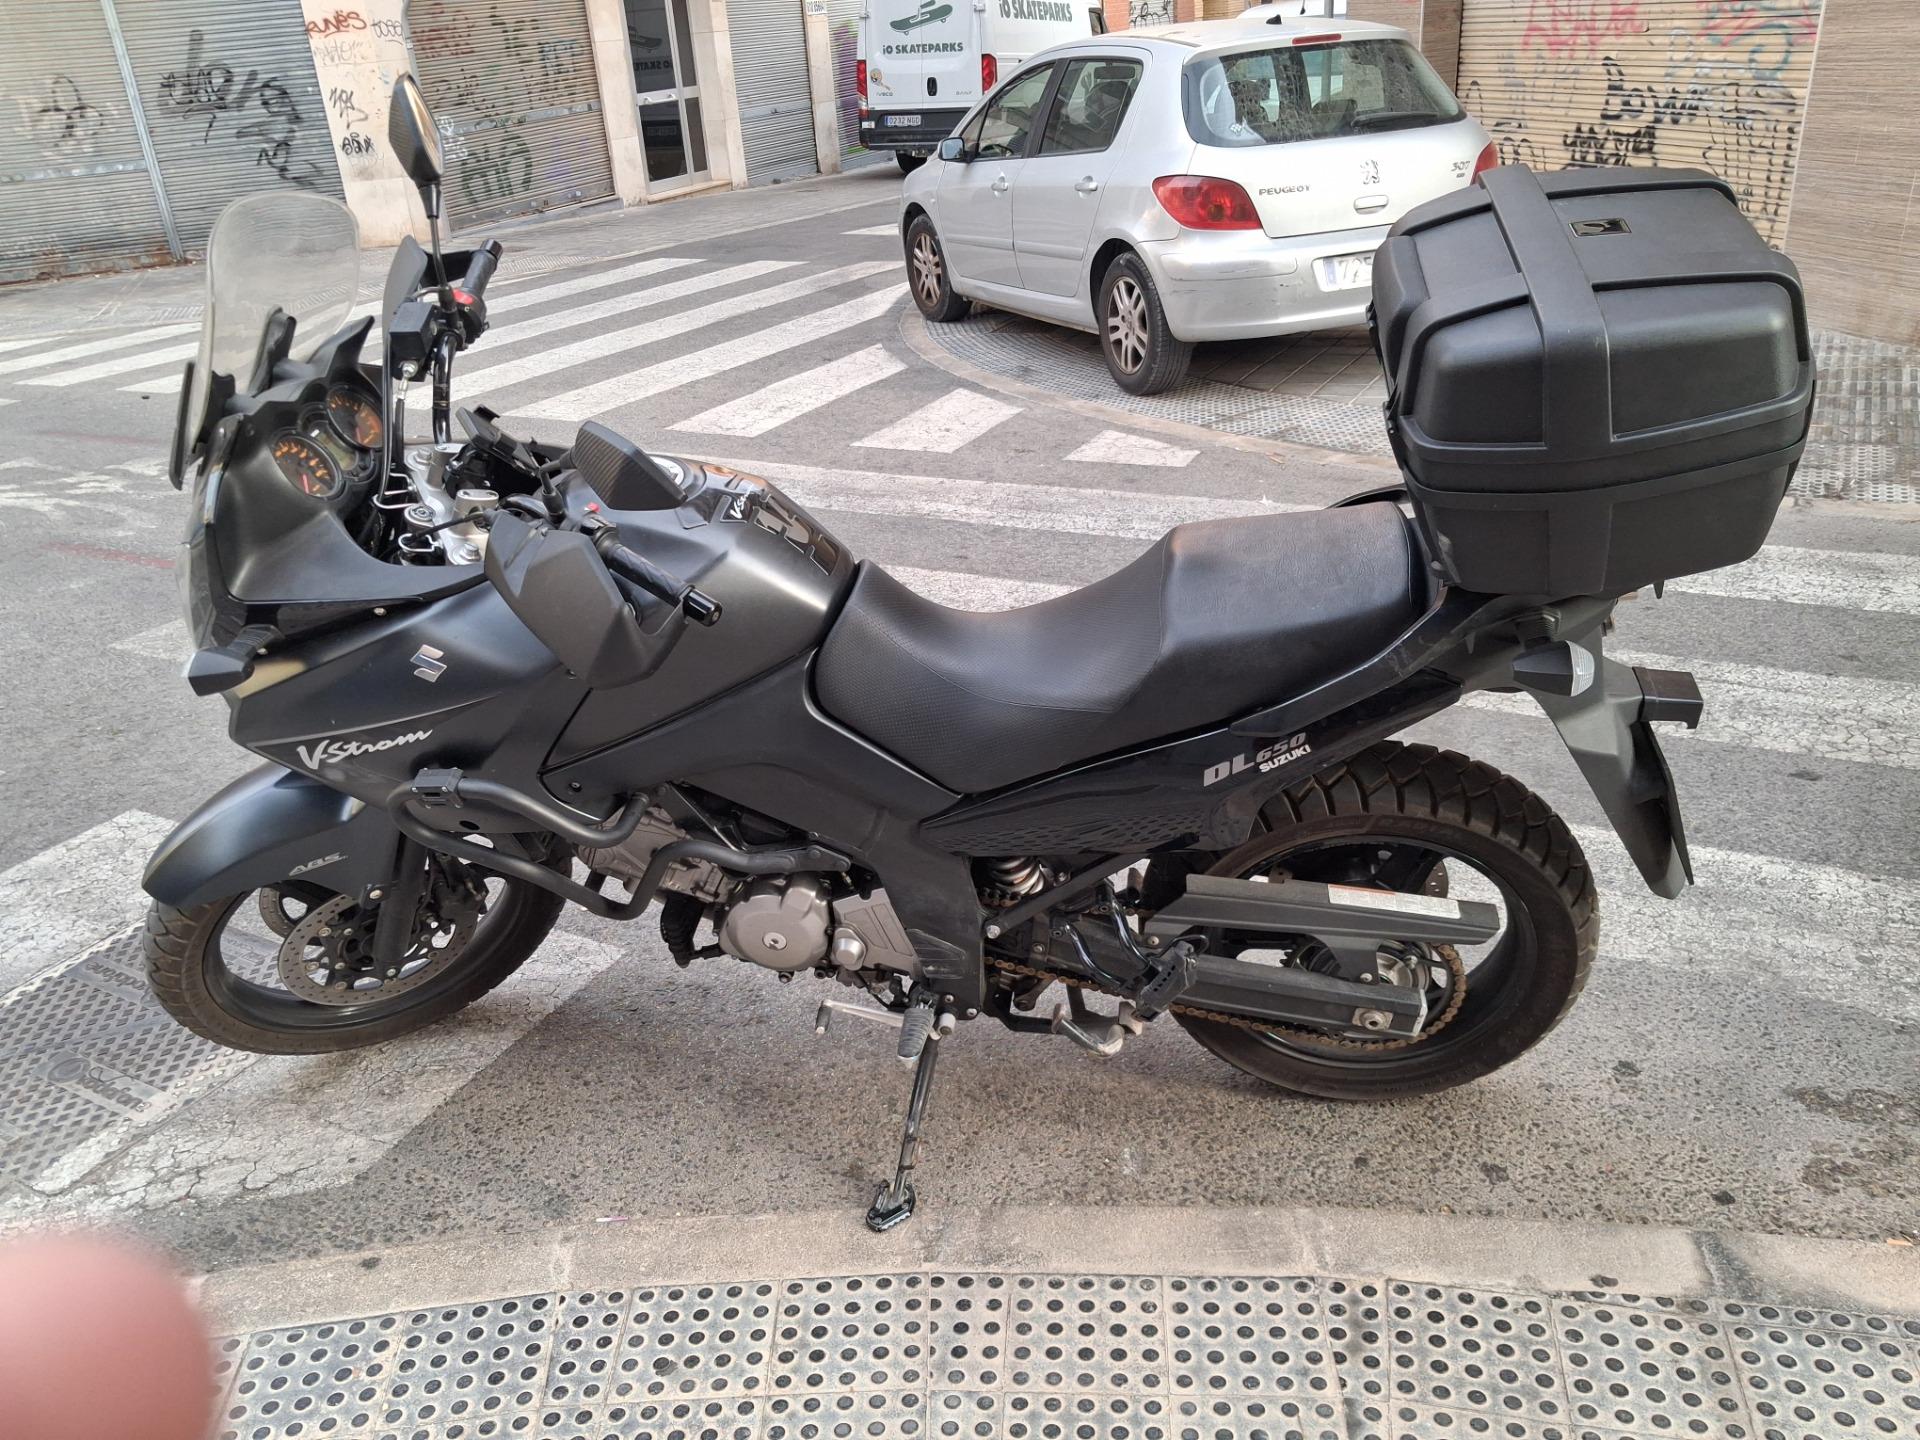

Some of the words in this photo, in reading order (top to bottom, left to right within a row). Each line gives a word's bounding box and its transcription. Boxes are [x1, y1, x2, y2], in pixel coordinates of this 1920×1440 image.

[1012, 0, 1072, 22] SKATEPARKS
[895, 42, 963, 54] SKATEPARKS
[1451, 160, 1471, 171] 307
[1259, 184, 1311, 196] PEUGEOT
[1203, 753, 1255, 787] DL
[1256, 732, 1306, 763] 650
[1259, 744, 1312, 773] SUZUKI
